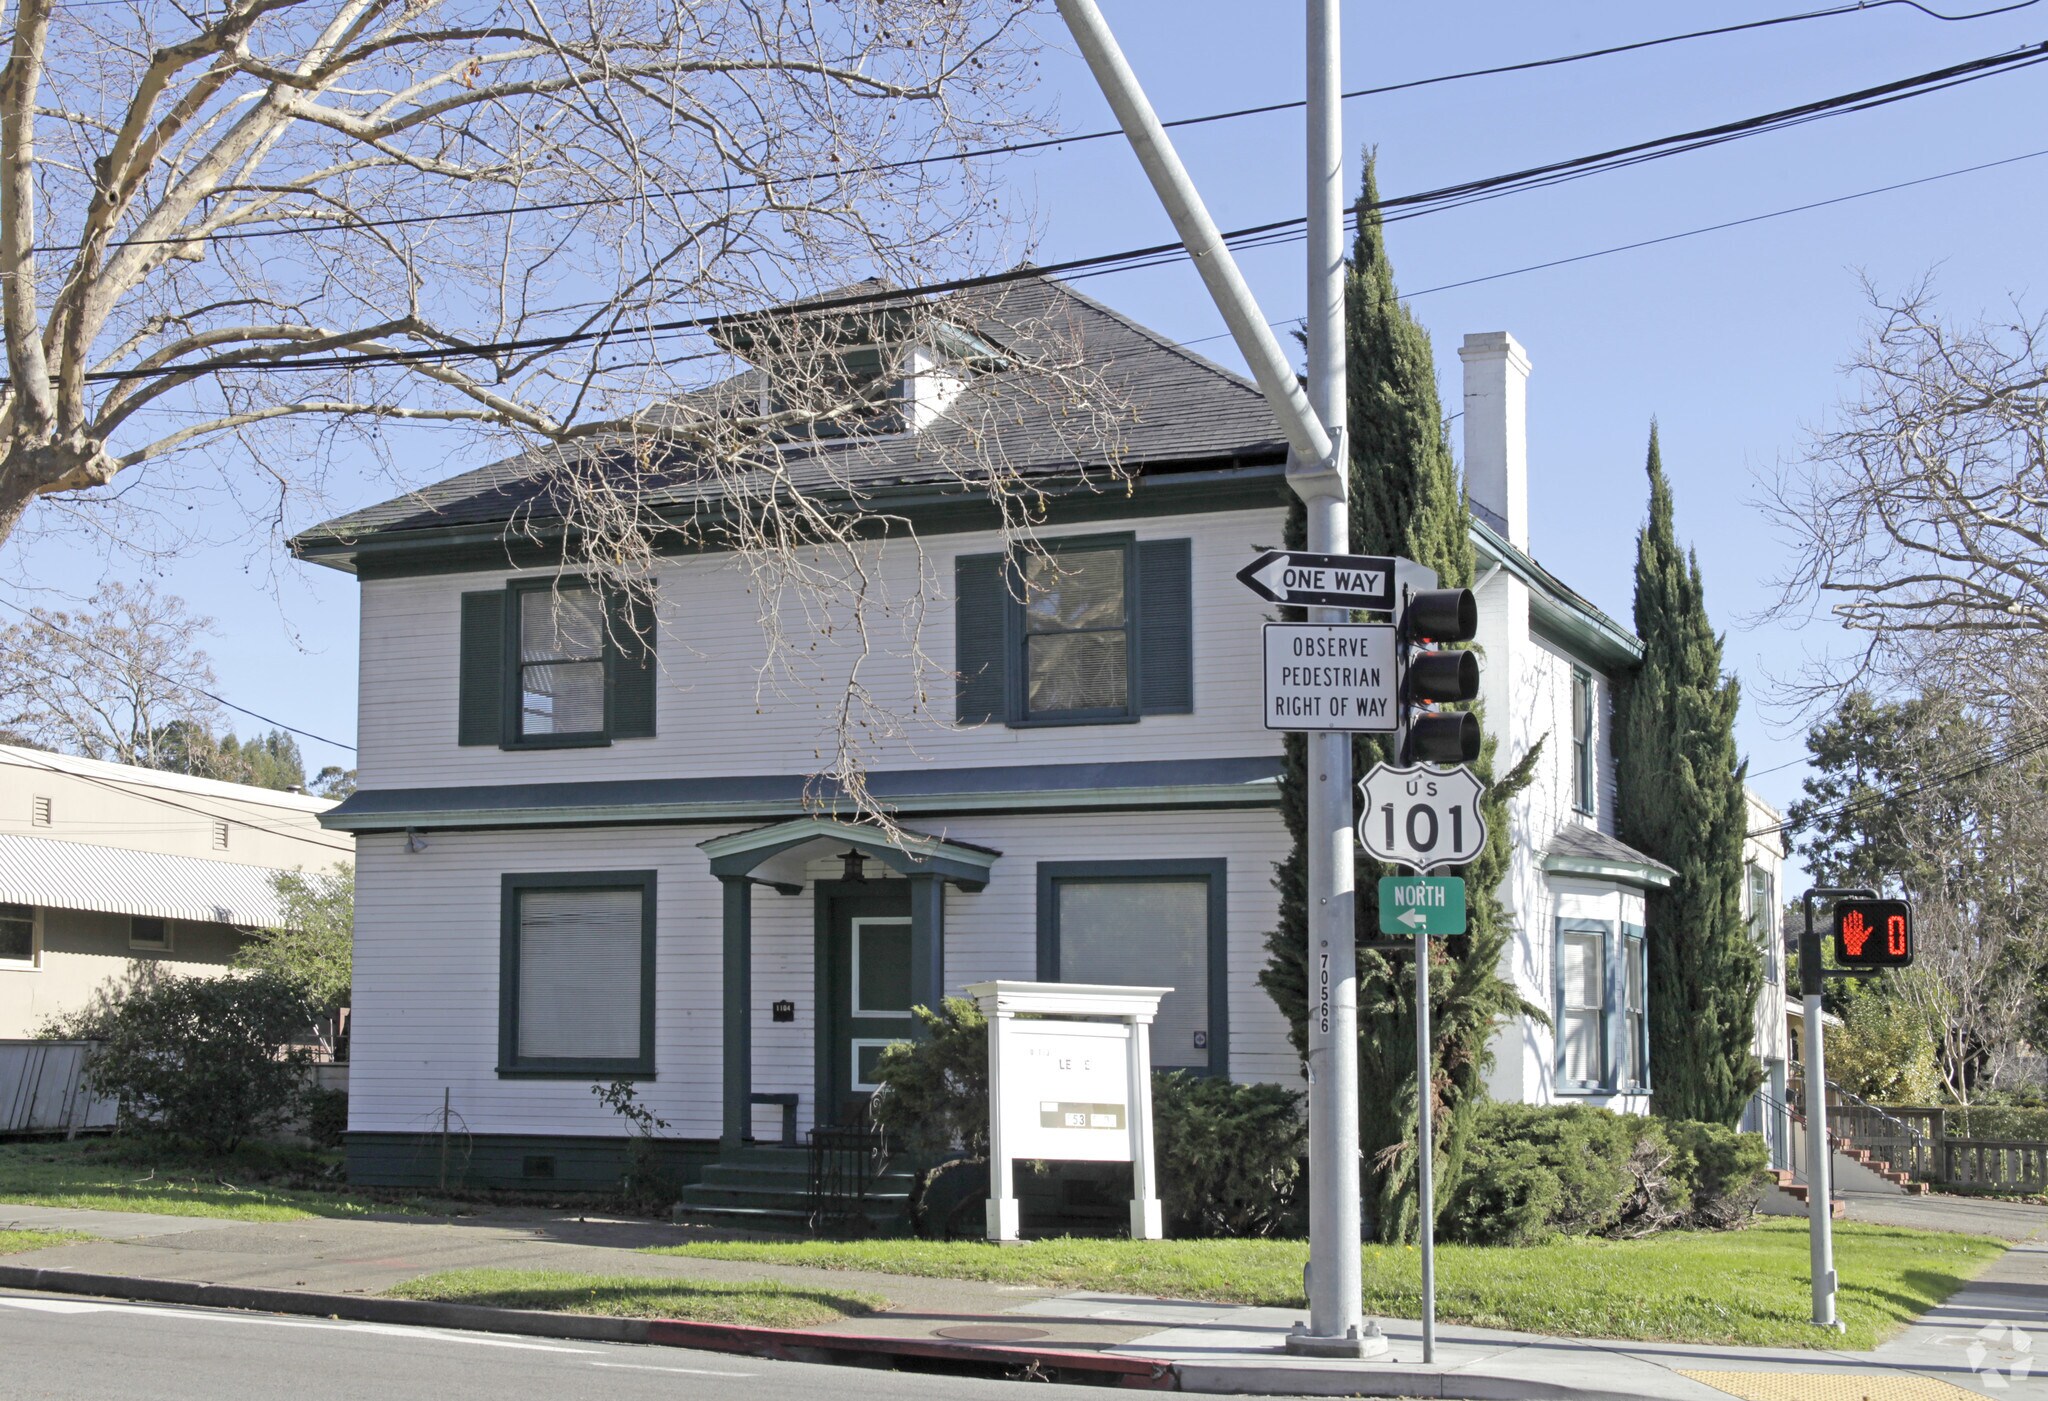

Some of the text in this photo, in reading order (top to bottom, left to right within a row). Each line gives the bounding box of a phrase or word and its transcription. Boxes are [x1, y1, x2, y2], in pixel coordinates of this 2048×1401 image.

[1283, 568, 1379, 593] ONE WAY
[1293, 636, 1369, 658] OBSERVE
[1282, 666, 1380, 688] PEDESTRIAN
[1275, 696, 1388, 718] RIGHT OF WAY
[1381, 802, 1463, 853] 101
[1394, 885, 1445, 907] NORTH
[1887, 915, 1906, 955] 0
[1320, 954, 1329, 1033] 70566
